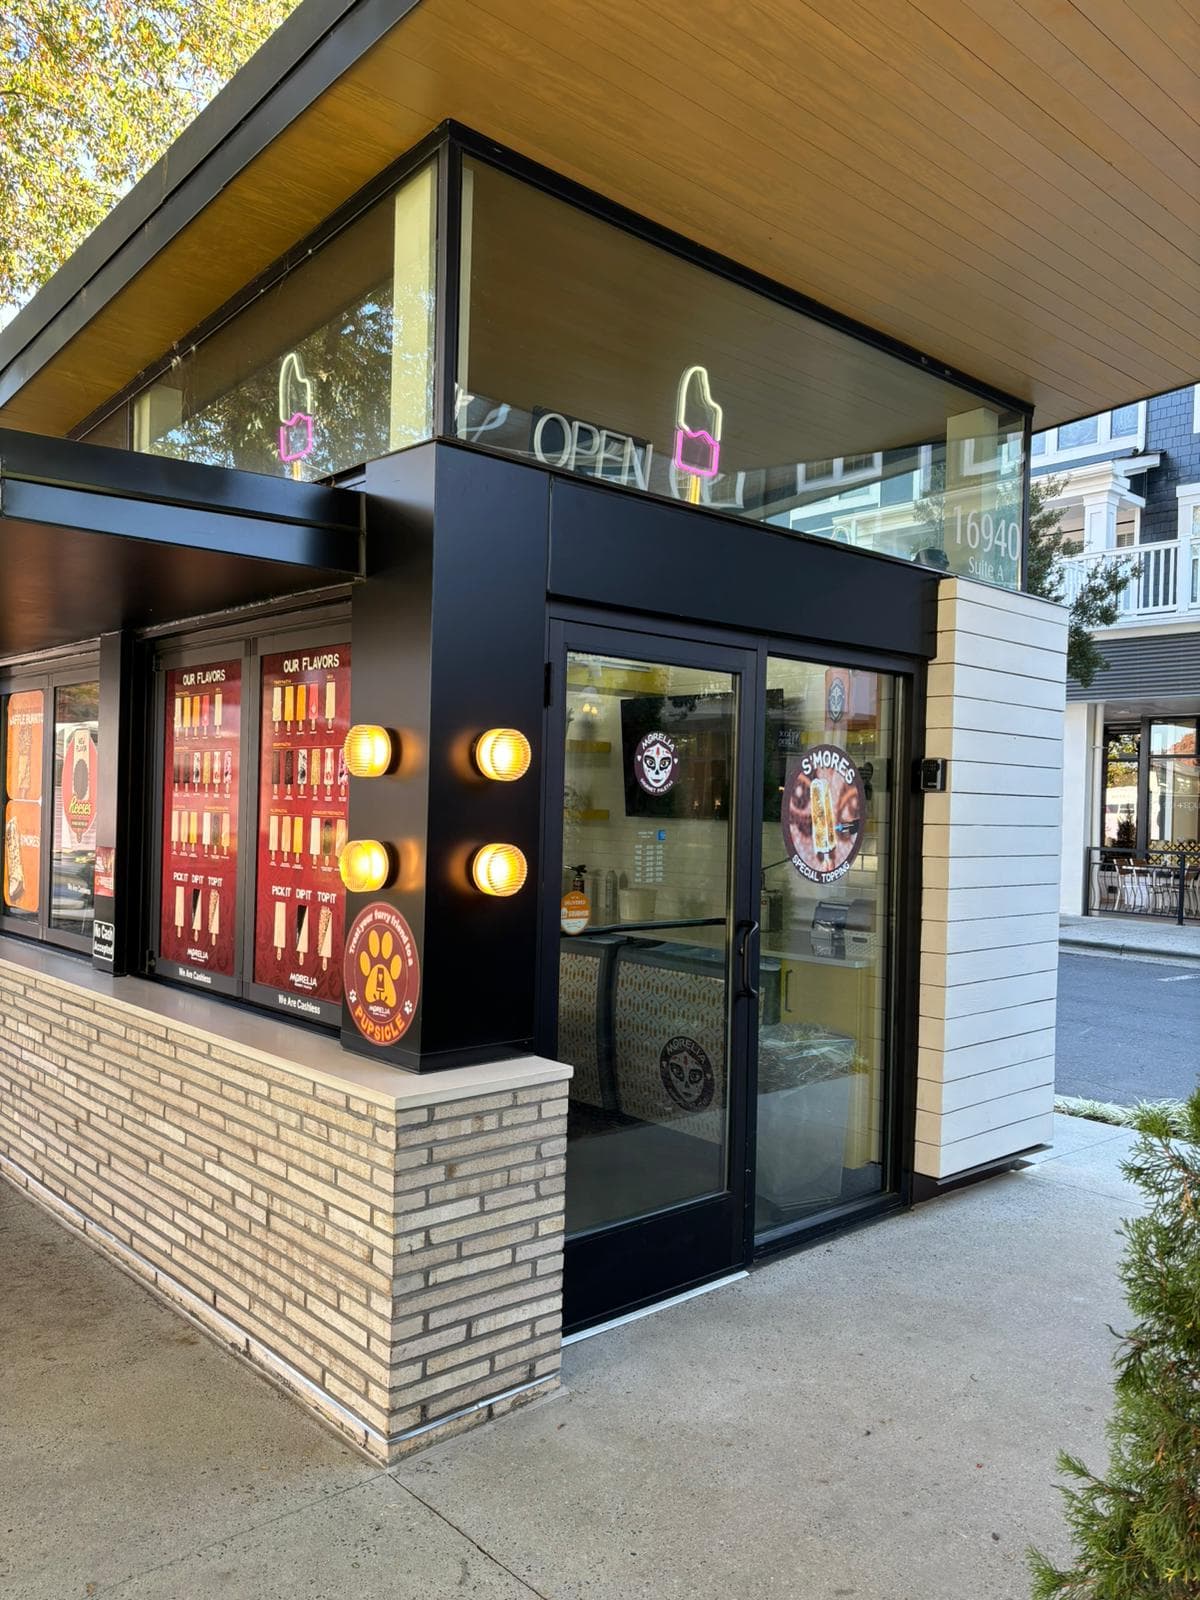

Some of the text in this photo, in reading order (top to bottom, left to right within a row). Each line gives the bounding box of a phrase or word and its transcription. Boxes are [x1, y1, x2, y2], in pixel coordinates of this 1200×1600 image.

[534, 413, 653, 491] OPEN
[954, 505, 1020, 561] 16940
[969, 556, 1004, 581] Suite A
[283, 653, 340, 673] OUR FLAVORS
[183, 669, 226, 686] OUR FLAVORS
[642, 732, 675, 752] MORELIA
[802, 750, 856, 784] S'MORES
[792, 854, 850, 883] SPECIAL TOPPING
[102, 925, 113, 941] Cash
[359, 912, 373, 932] your
[374, 909, 391, 924] furry
[391, 915, 408, 945] friend
[405, 943, 411, 957] to
[289, 972, 317, 987] MORELIA
[278, 994, 320, 1015] We Are Cashless
[354, 1004, 405, 1042] PUPSICLE
